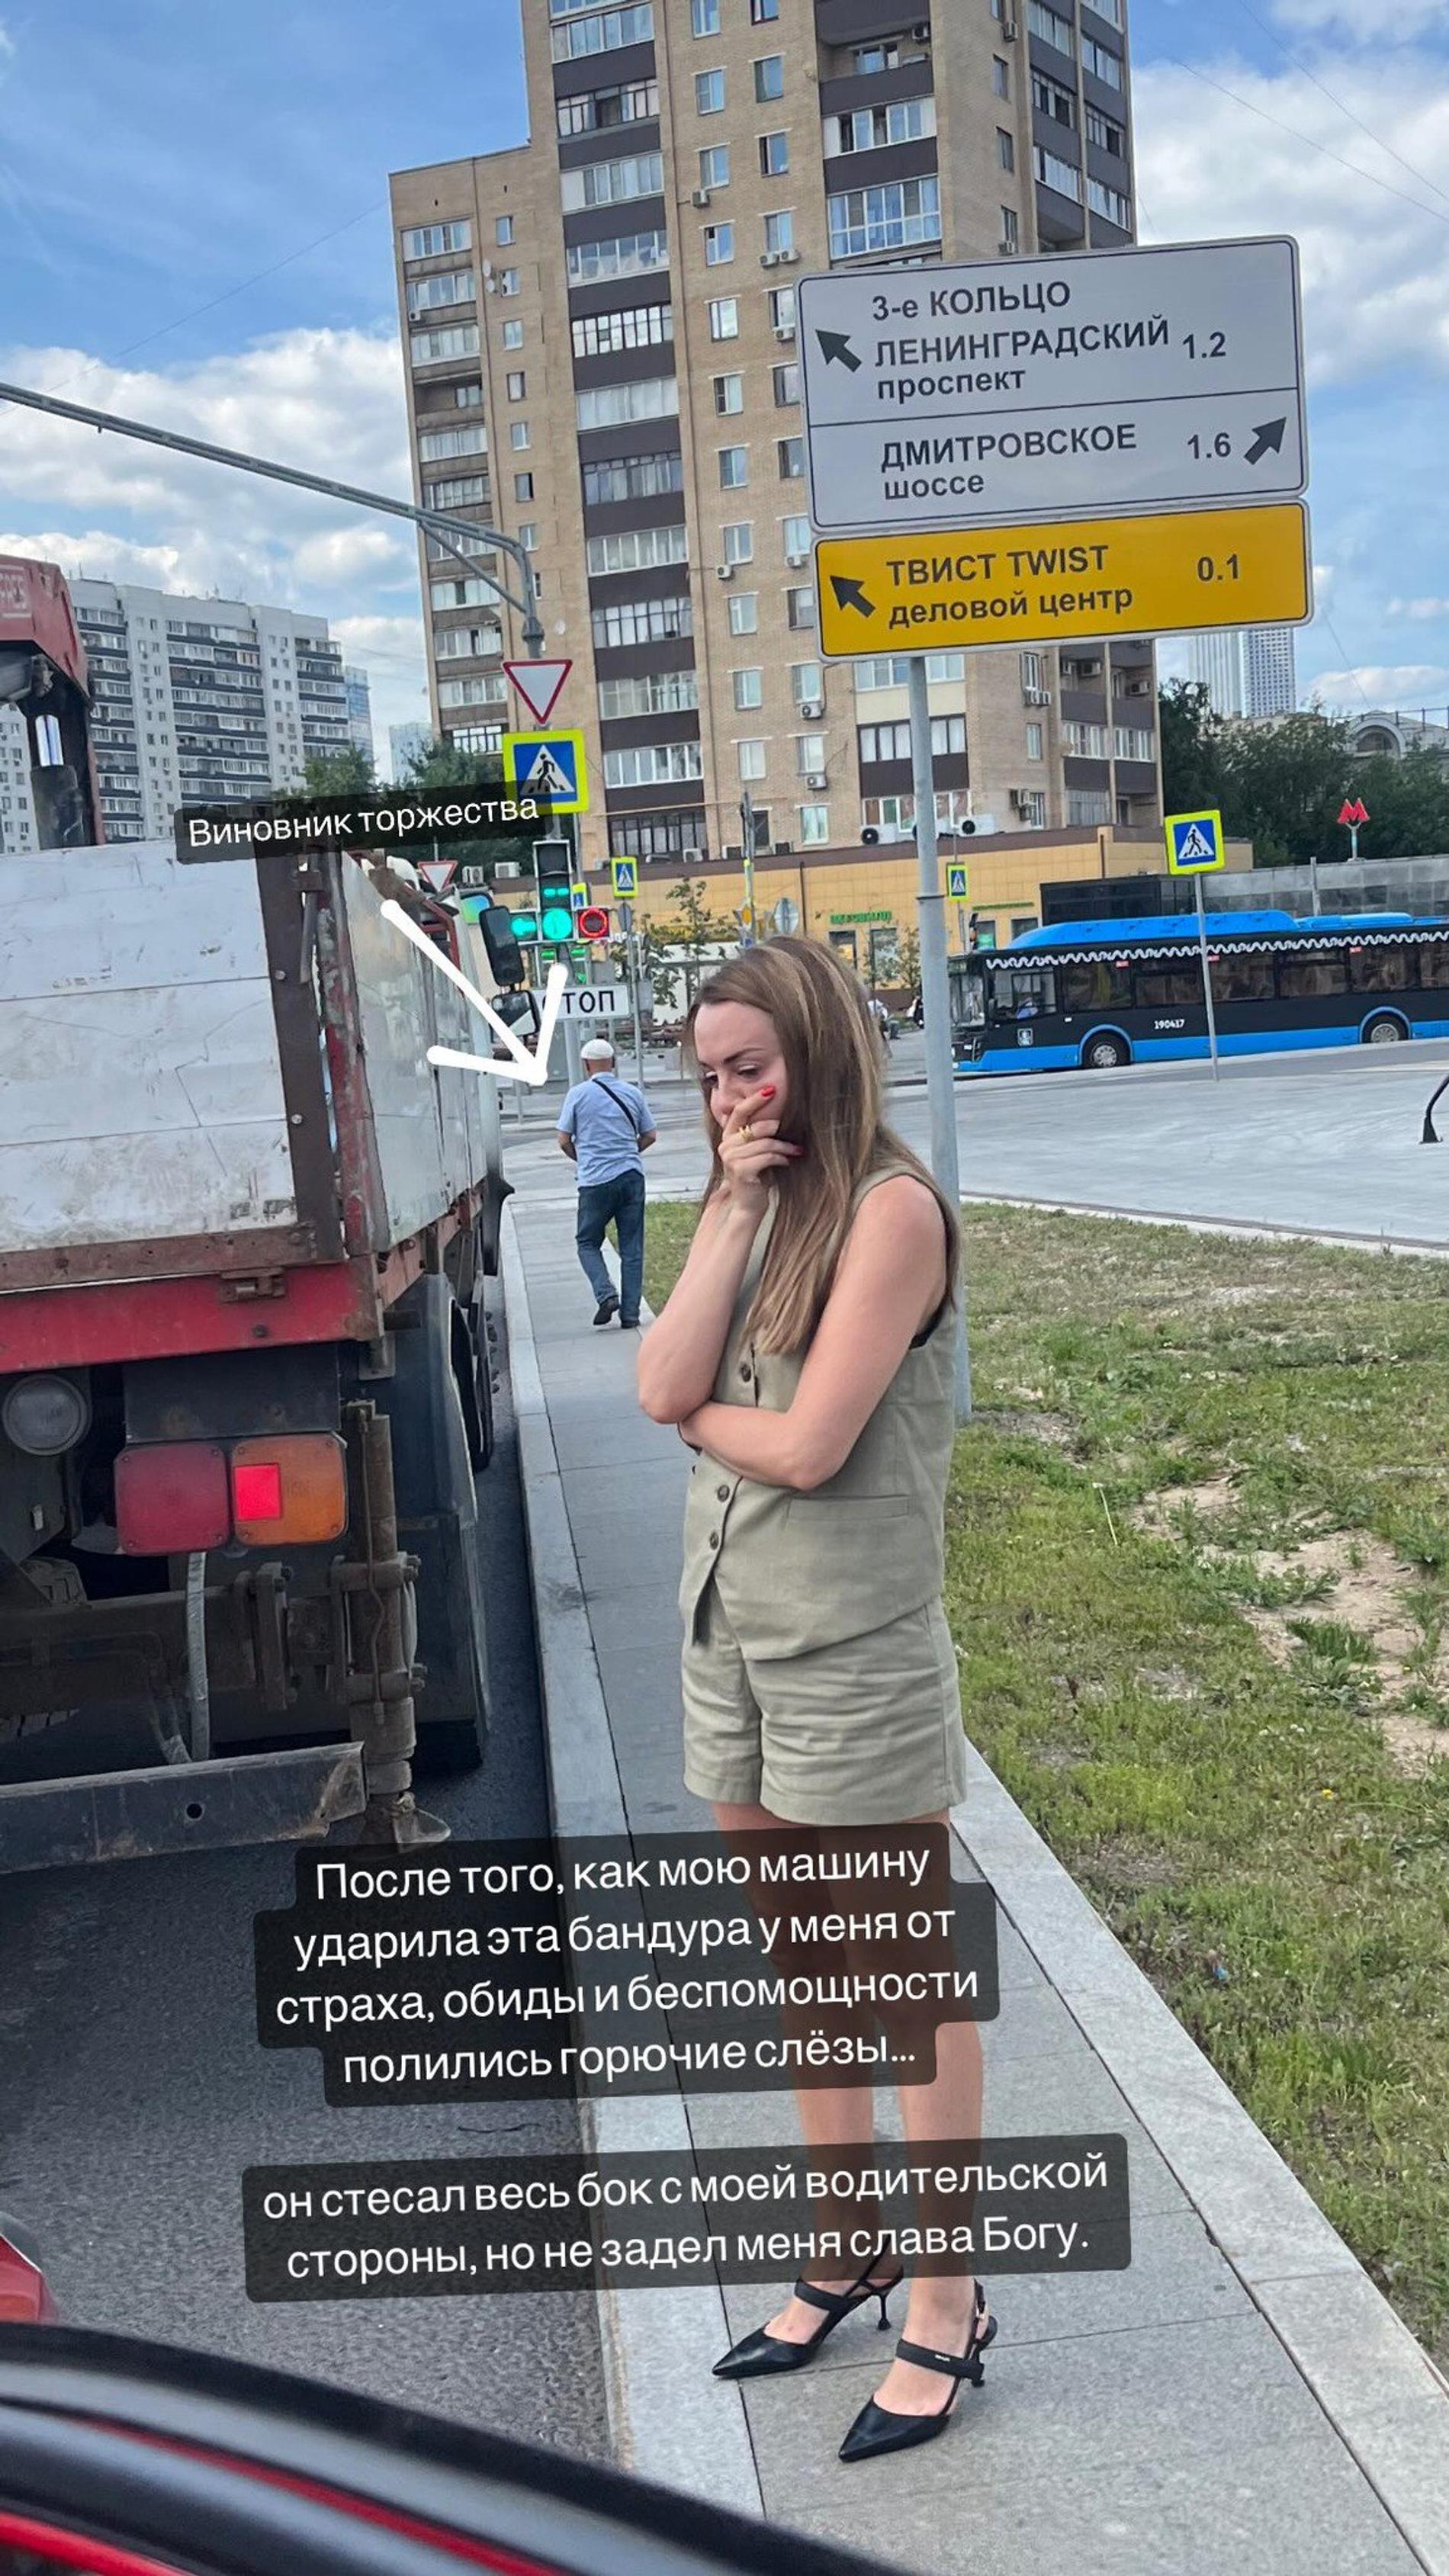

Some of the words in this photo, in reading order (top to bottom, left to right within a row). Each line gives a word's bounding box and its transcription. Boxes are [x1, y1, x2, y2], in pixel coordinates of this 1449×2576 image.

[872, 294, 918, 321] 3-е
[930, 281, 1071, 317] КОЛЬЦО
[876, 314, 1169, 366] ЛЕНИНГРАДСКИЙ
[1182, 332, 1226, 360] 1.2
[878, 369, 1026, 403] проспект
[882, 424, 1137, 472] ДМИТРОВСКОЕ
[1187, 432, 1232, 459] 1.6
[884, 474, 985, 500] шоссе
[887, 554, 996, 586] ТВИСТ
[1007, 545, 1109, 577] TWIST
[1197, 555, 1239, 582] 0.1
[888, 592, 1028, 629] деловой
[1039, 587, 1133, 615] центр
[542, 991, 614, 1013] ТОП
